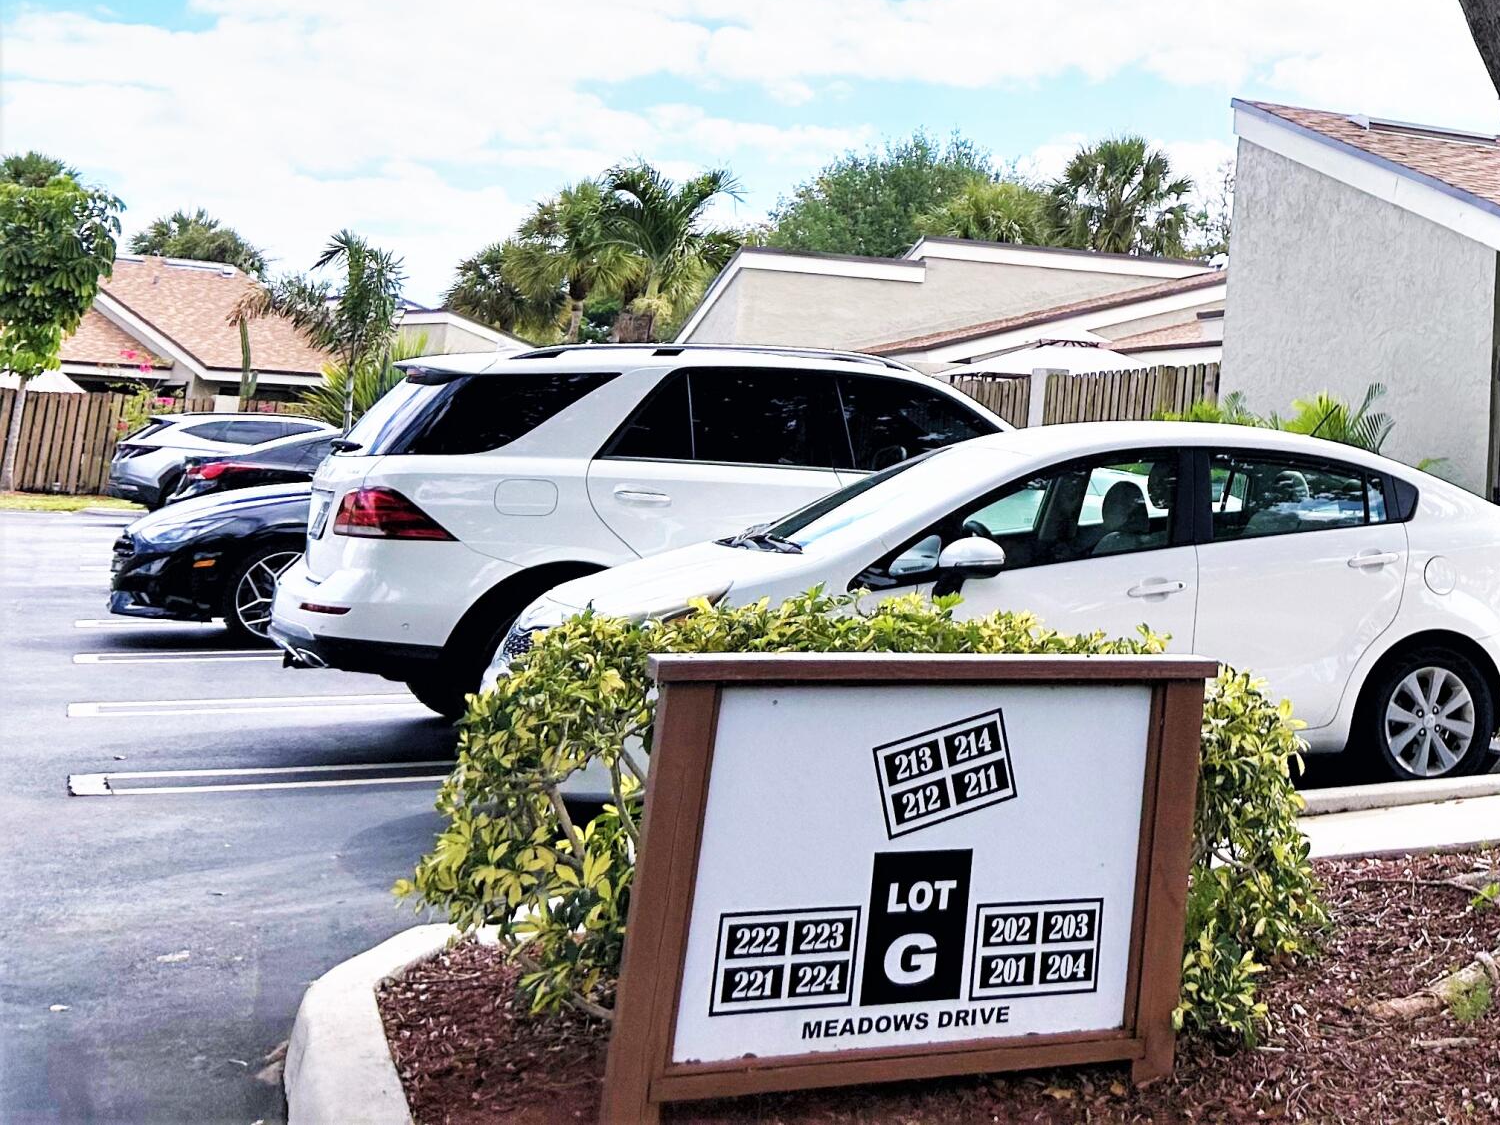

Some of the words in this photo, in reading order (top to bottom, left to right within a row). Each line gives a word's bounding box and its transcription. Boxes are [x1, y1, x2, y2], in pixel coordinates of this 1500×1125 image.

[894, 746, 933, 780] 213
[954, 727, 992, 761] 214
[902, 785, 941, 820] 212
[964, 764, 998, 798] 211
[887, 880, 957, 913] LOT
[733, 926, 780, 955] 222
[800, 922, 844, 951] 223
[989, 916, 1031, 943] 202
[1049, 913, 1089, 940] 203
[884, 933, 937, 985] G
[988, 957, 1026, 984] 201
[1046, 953, 1086, 980] 204
[731, 969, 774, 999] 221
[796, 964, 840, 994] 224
[802, 1012, 929, 1039] MEADOWS
[938, 1006, 1010, 1028] DRIVE
